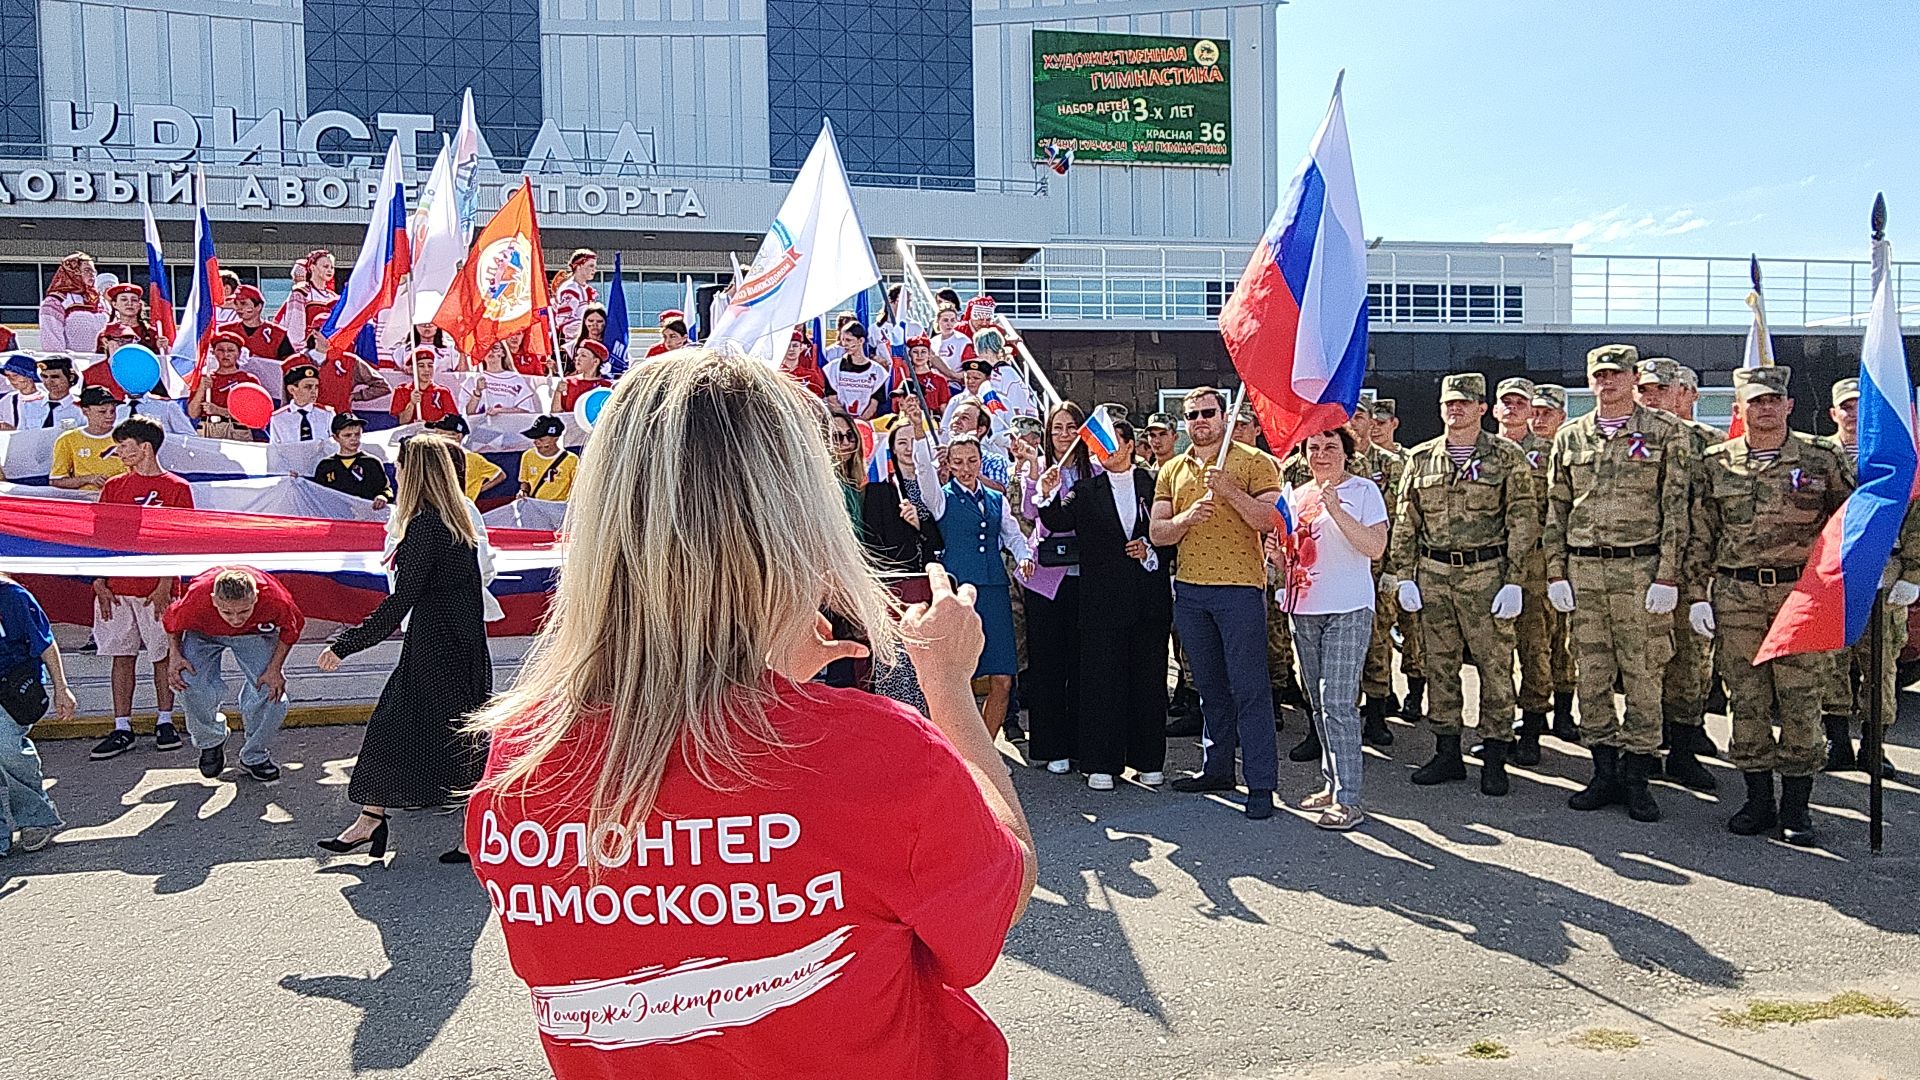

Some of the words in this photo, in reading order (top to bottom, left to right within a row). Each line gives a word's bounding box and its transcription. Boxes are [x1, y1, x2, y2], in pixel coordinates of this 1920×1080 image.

[1042, 46, 1188, 71] ХУДОЖЕСТВЕННАЯ
[1091, 64, 1224, 91] ГИМНАСТИКА
[1057, 102, 1095, 116] НАБОР
[1096, 97, 1131, 115] ДЕТЕЙ
[1111, 110, 1131, 123] ОТ
[1169, 104, 1195, 119] ЛЕТ
[1145, 128, 1193, 141] КРАСНАЯ
[1199, 122, 1226, 143] 36
[236, 174, 419, 210] ДВОРЕ
[499, 181, 707, 219] СПОРТА
[480, 809, 801, 870] ВОЛОНТЕР
